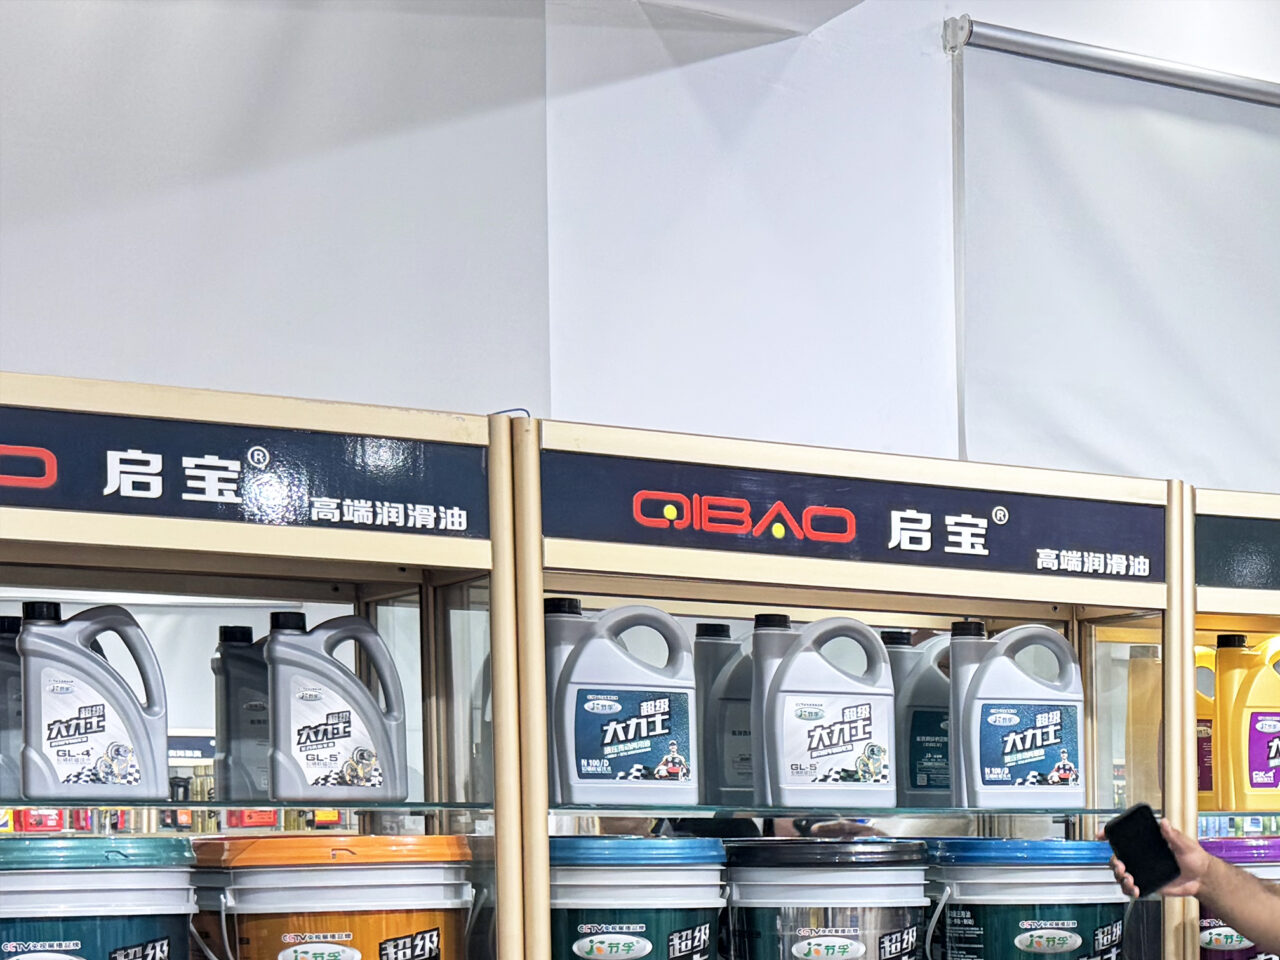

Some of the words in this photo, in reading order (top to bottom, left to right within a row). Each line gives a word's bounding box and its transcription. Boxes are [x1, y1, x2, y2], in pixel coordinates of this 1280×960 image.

[310, 497, 468, 531] 高端润滑油
[632, 490, 856, 543] QIBAO
[1036, 548, 1150, 577] 高端润滑油
[79, 704, 105, 718] 超级
[640, 698, 669, 716] 超级
[842, 703, 871, 721] 超级
[1036, 711, 1061, 727] 超级
[47, 715, 105, 740] 大力士
[297, 722, 351, 745] 大力士
[602, 714, 669, 745] 大力士
[808, 719, 872, 751] 大力士
[1003, 724, 1062, 754] 大力士
[668, 923, 710, 958] 超级
[879, 927, 917, 960] 超级
[1046, 936, 1069, 946] 节孚
[1094, 920, 1122, 950] 超级
[608, 943, 635, 955] 节孚
[824, 944, 850, 956] 节孚
